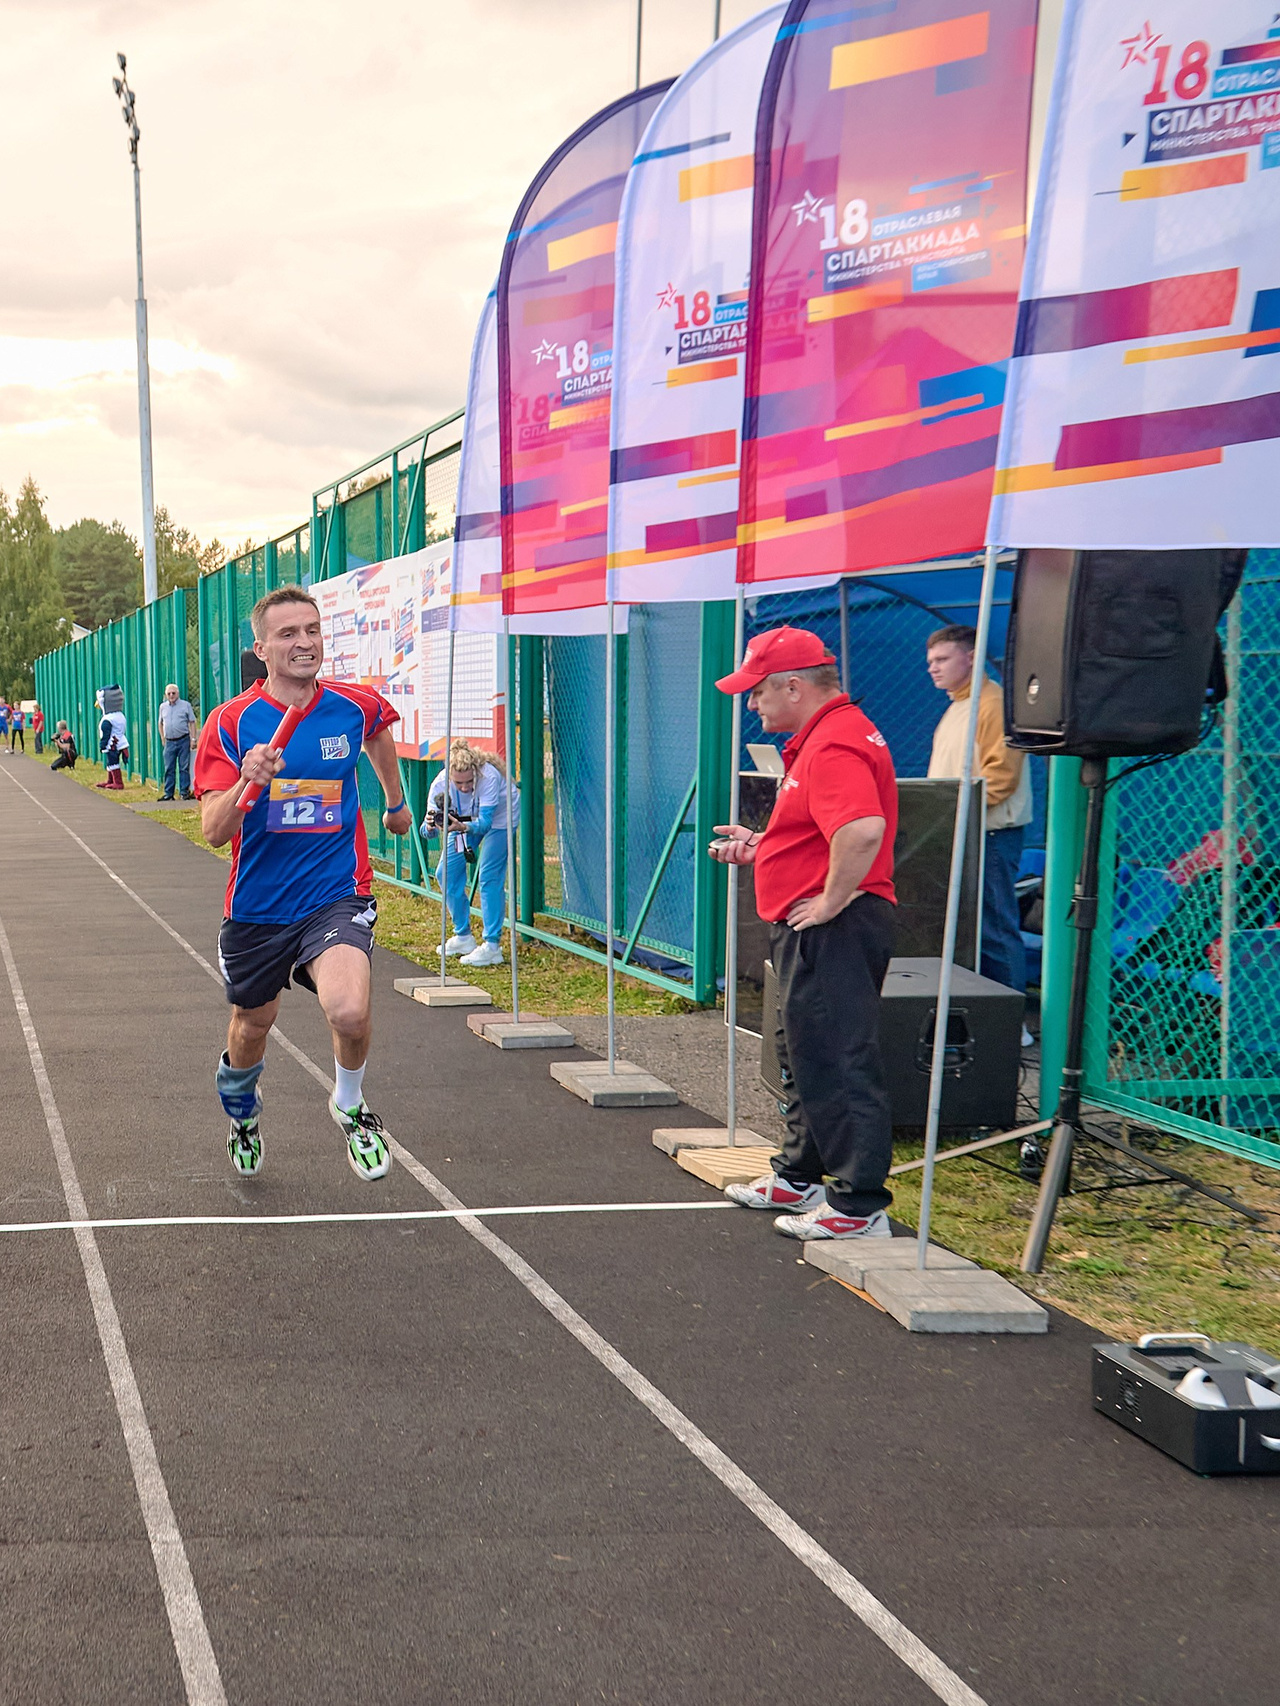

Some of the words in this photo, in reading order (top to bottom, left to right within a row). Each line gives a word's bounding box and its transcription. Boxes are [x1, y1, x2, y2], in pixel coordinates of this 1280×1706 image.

[1143, 40, 1210, 105] 18
[1150, 125, 1249, 152] МИНИСТЕРСТВА
[820, 198, 869, 251] 18
[873, 204, 962, 237] ОТРАСЛЕВАЯ
[827, 224, 980, 272] СПАРТАКИАДА
[827, 261, 902, 284] МИНИСТЕРСТВА
[903, 246, 967, 266] ТРАНСПОРТА
[674, 290, 711, 330] 18
[555, 339, 589, 379] 18
[282, 801, 315, 825] 12
[325, 811, 334, 822] 6
